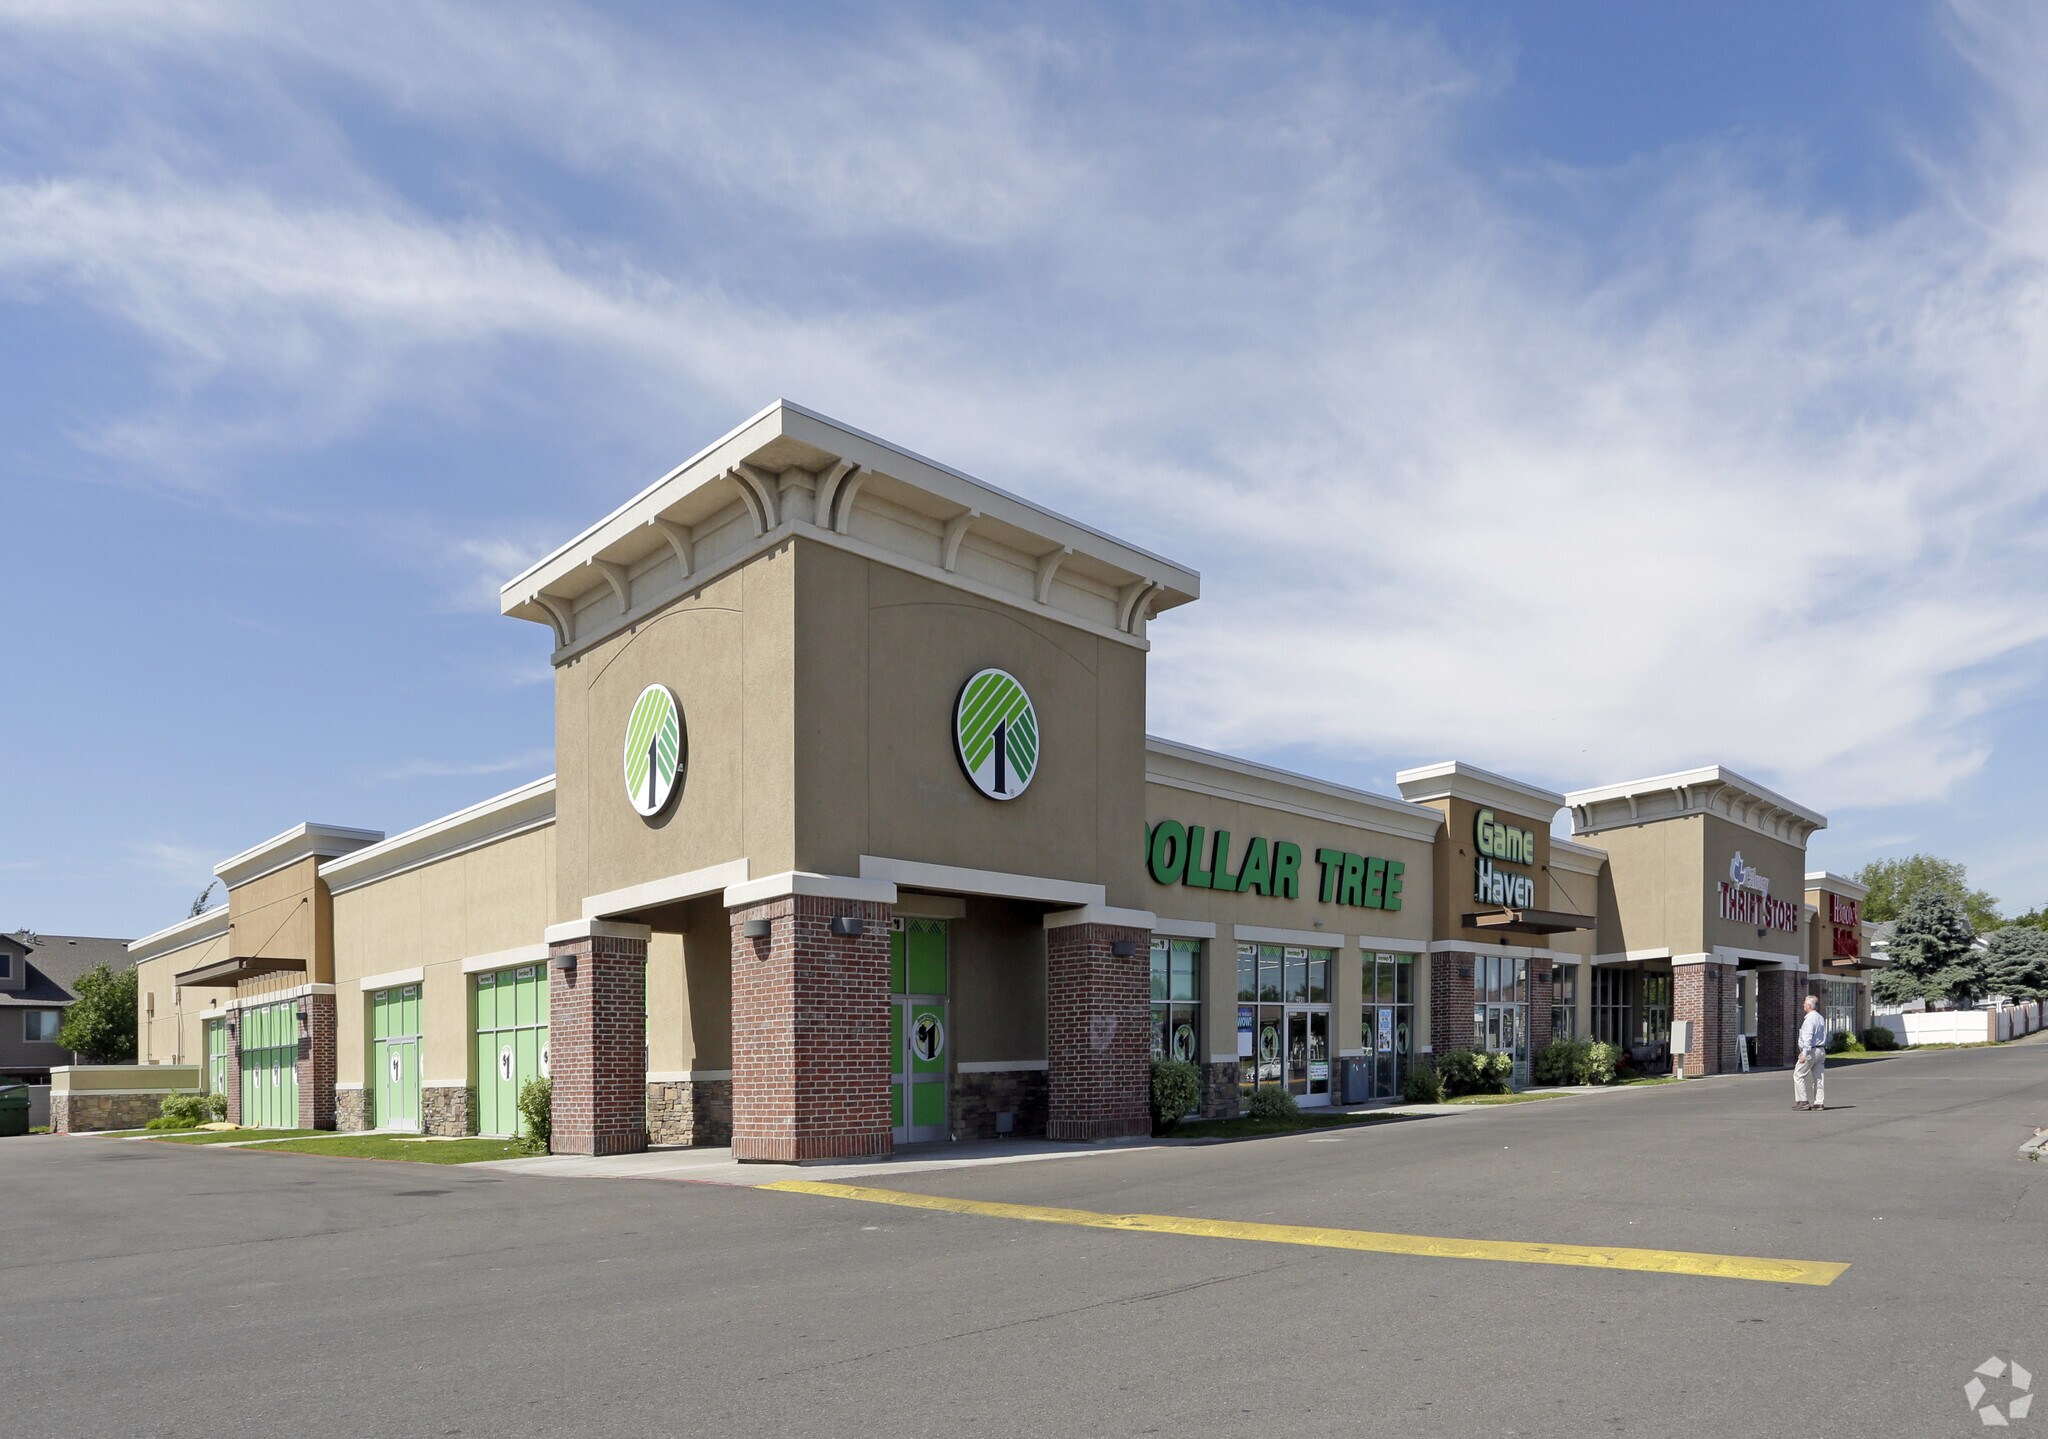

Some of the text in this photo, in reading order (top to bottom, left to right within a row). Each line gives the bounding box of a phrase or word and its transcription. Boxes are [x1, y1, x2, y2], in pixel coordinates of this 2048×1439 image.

[647, 730, 657, 809] 1
[992, 718, 1007, 794] 1
[1474, 809, 1534, 866] Game
[1145, 820, 1405, 911] OLLAR TREE
[1475, 857, 1535, 908] Haven
[1718, 882, 1798, 933] THRIFT STORE
[502, 1053, 510, 1080] $1
[918, 1023, 935, 1060] $1
